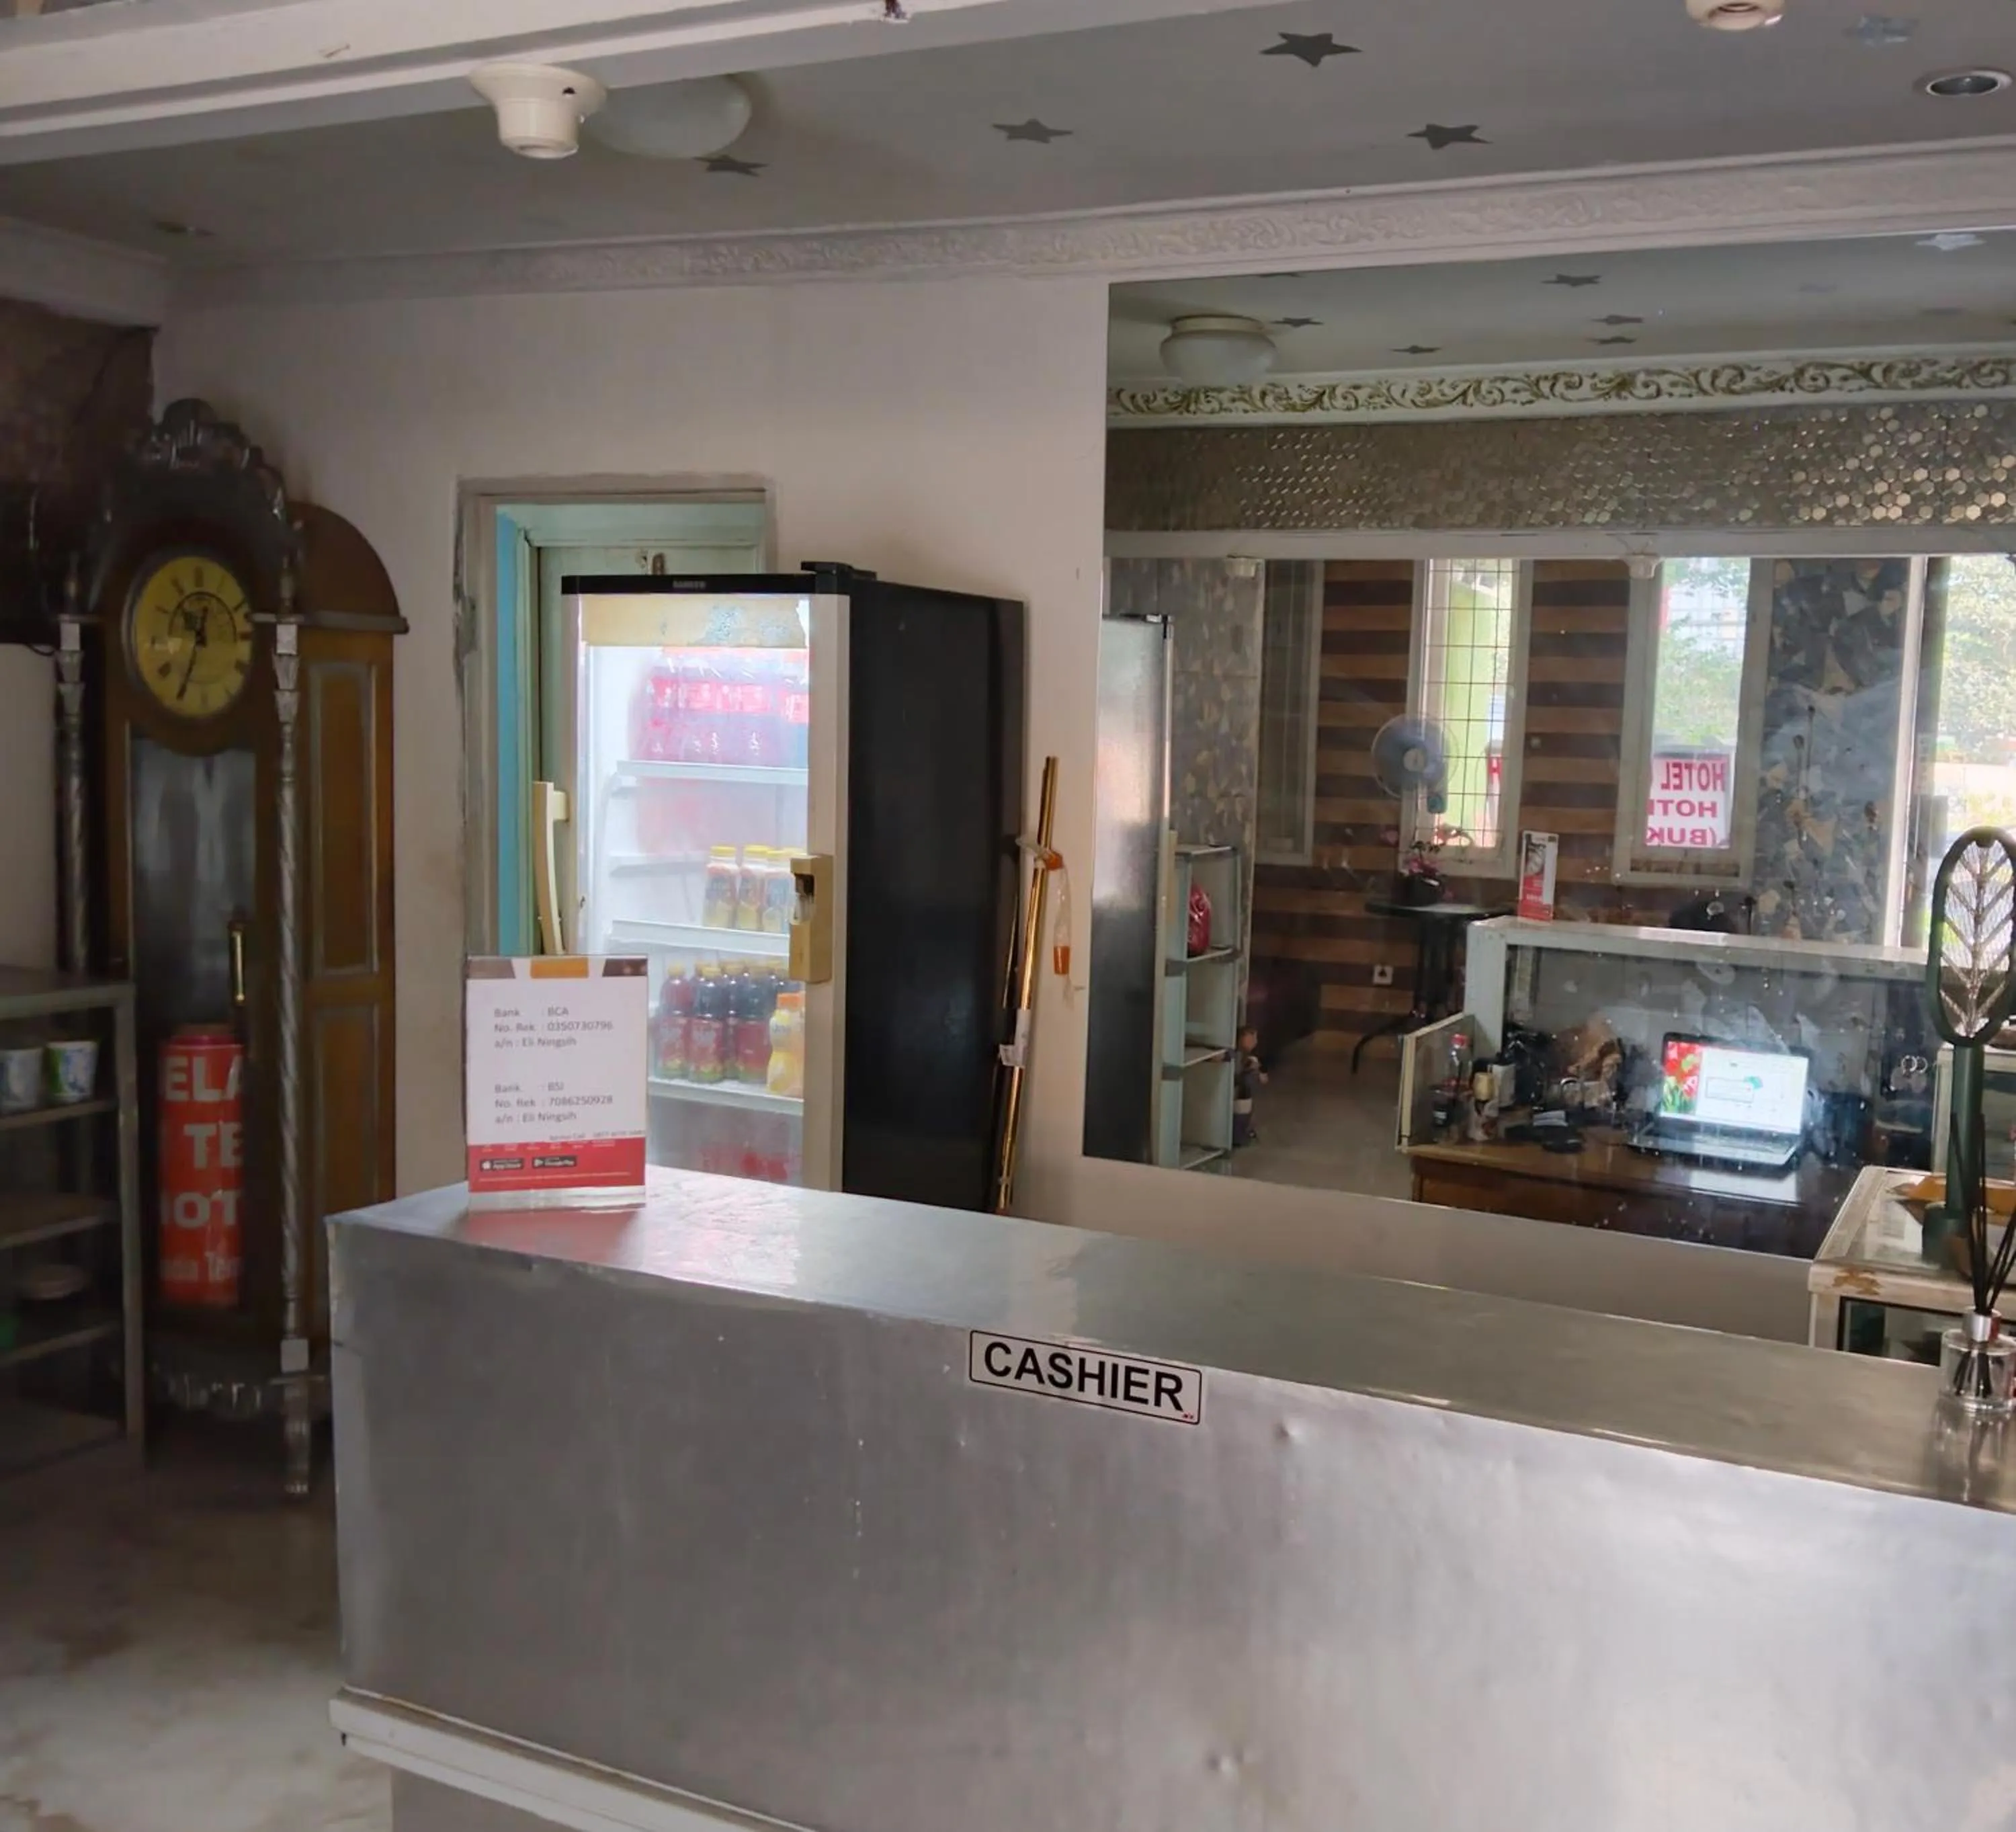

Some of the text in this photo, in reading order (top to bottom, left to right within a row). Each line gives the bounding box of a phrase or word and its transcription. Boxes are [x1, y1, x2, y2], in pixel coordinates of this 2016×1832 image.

[494, 1008, 520, 1017] Bank
[547, 1007, 569, 1016] BCA
[516, 1022, 536, 1032] Rek
[495, 1083, 521, 1093] Bank
[516, 1097, 536, 1108] Rek
[984, 1341, 1184, 1413] CASHIER
